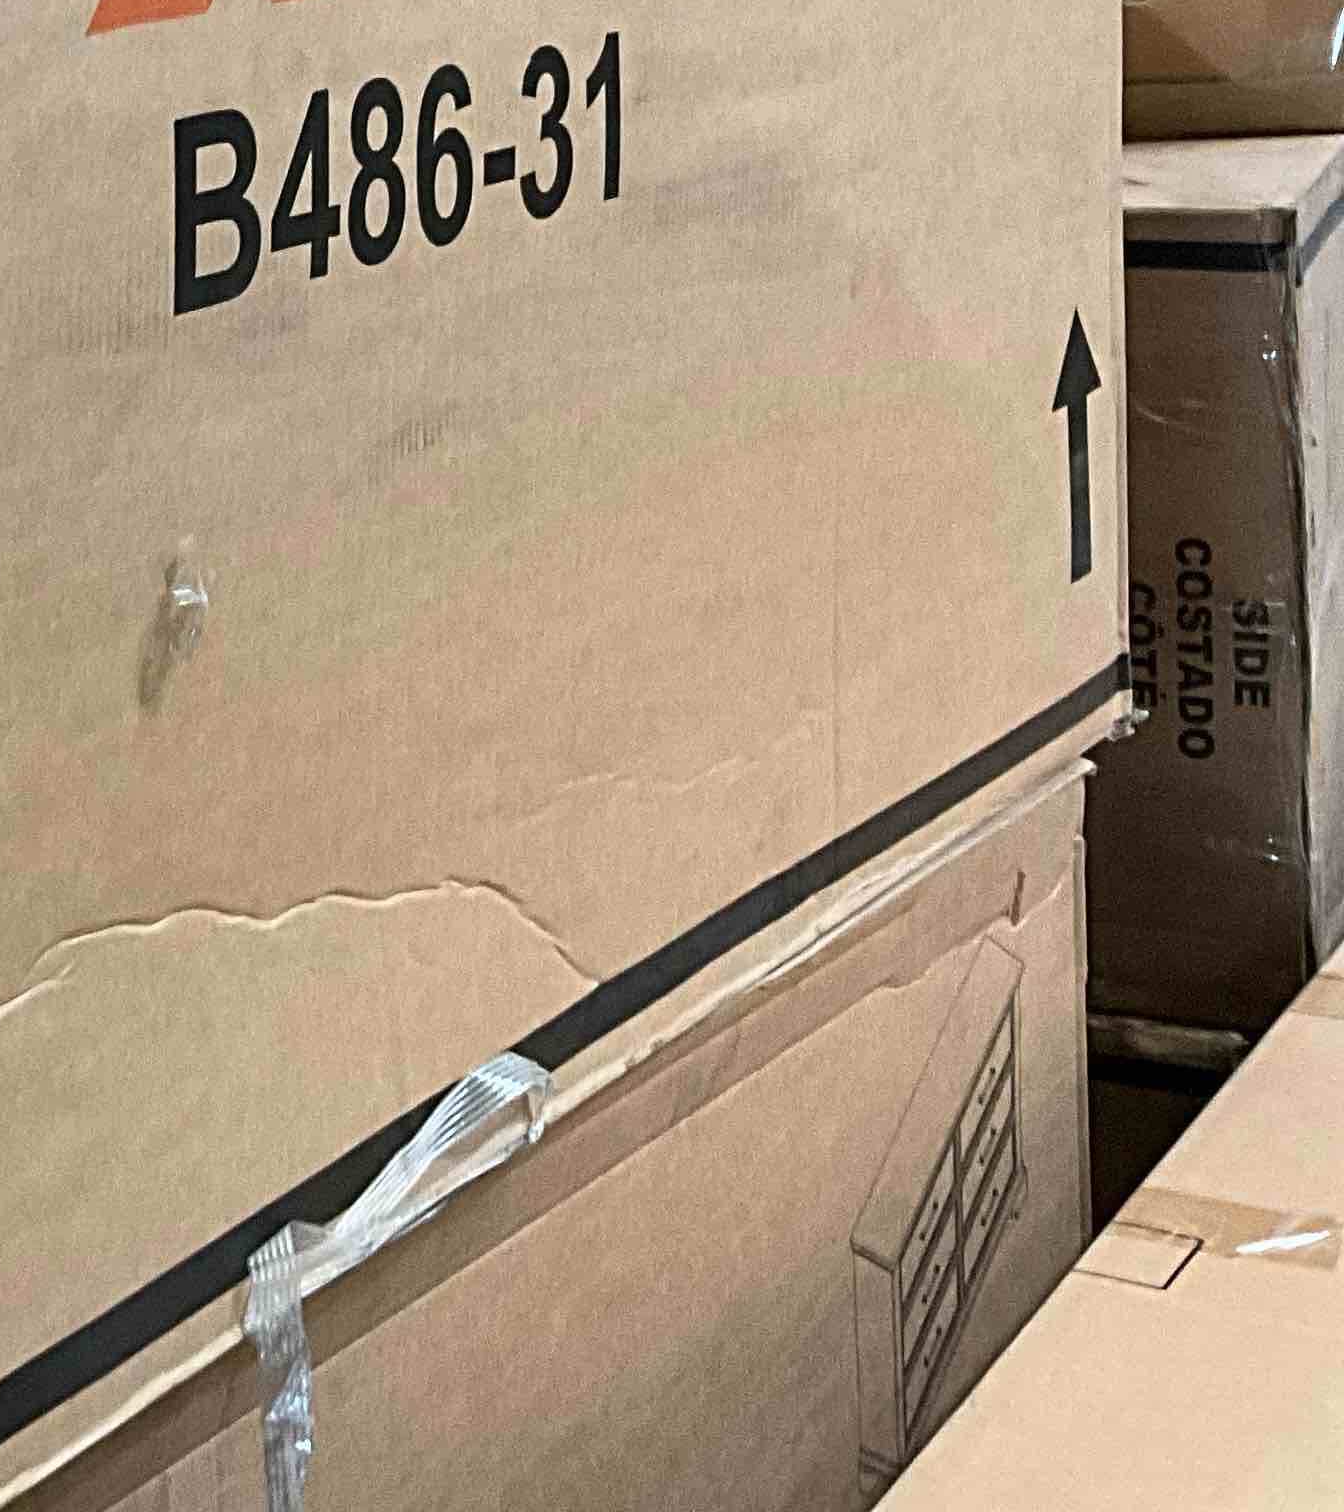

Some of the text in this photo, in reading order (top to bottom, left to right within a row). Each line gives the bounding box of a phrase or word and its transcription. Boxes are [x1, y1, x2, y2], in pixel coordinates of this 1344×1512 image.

[174, 31, 621, 316] B486-31
[1175, 538, 1214, 759] COSTADO
[1234, 600, 1270, 708] SIDE
